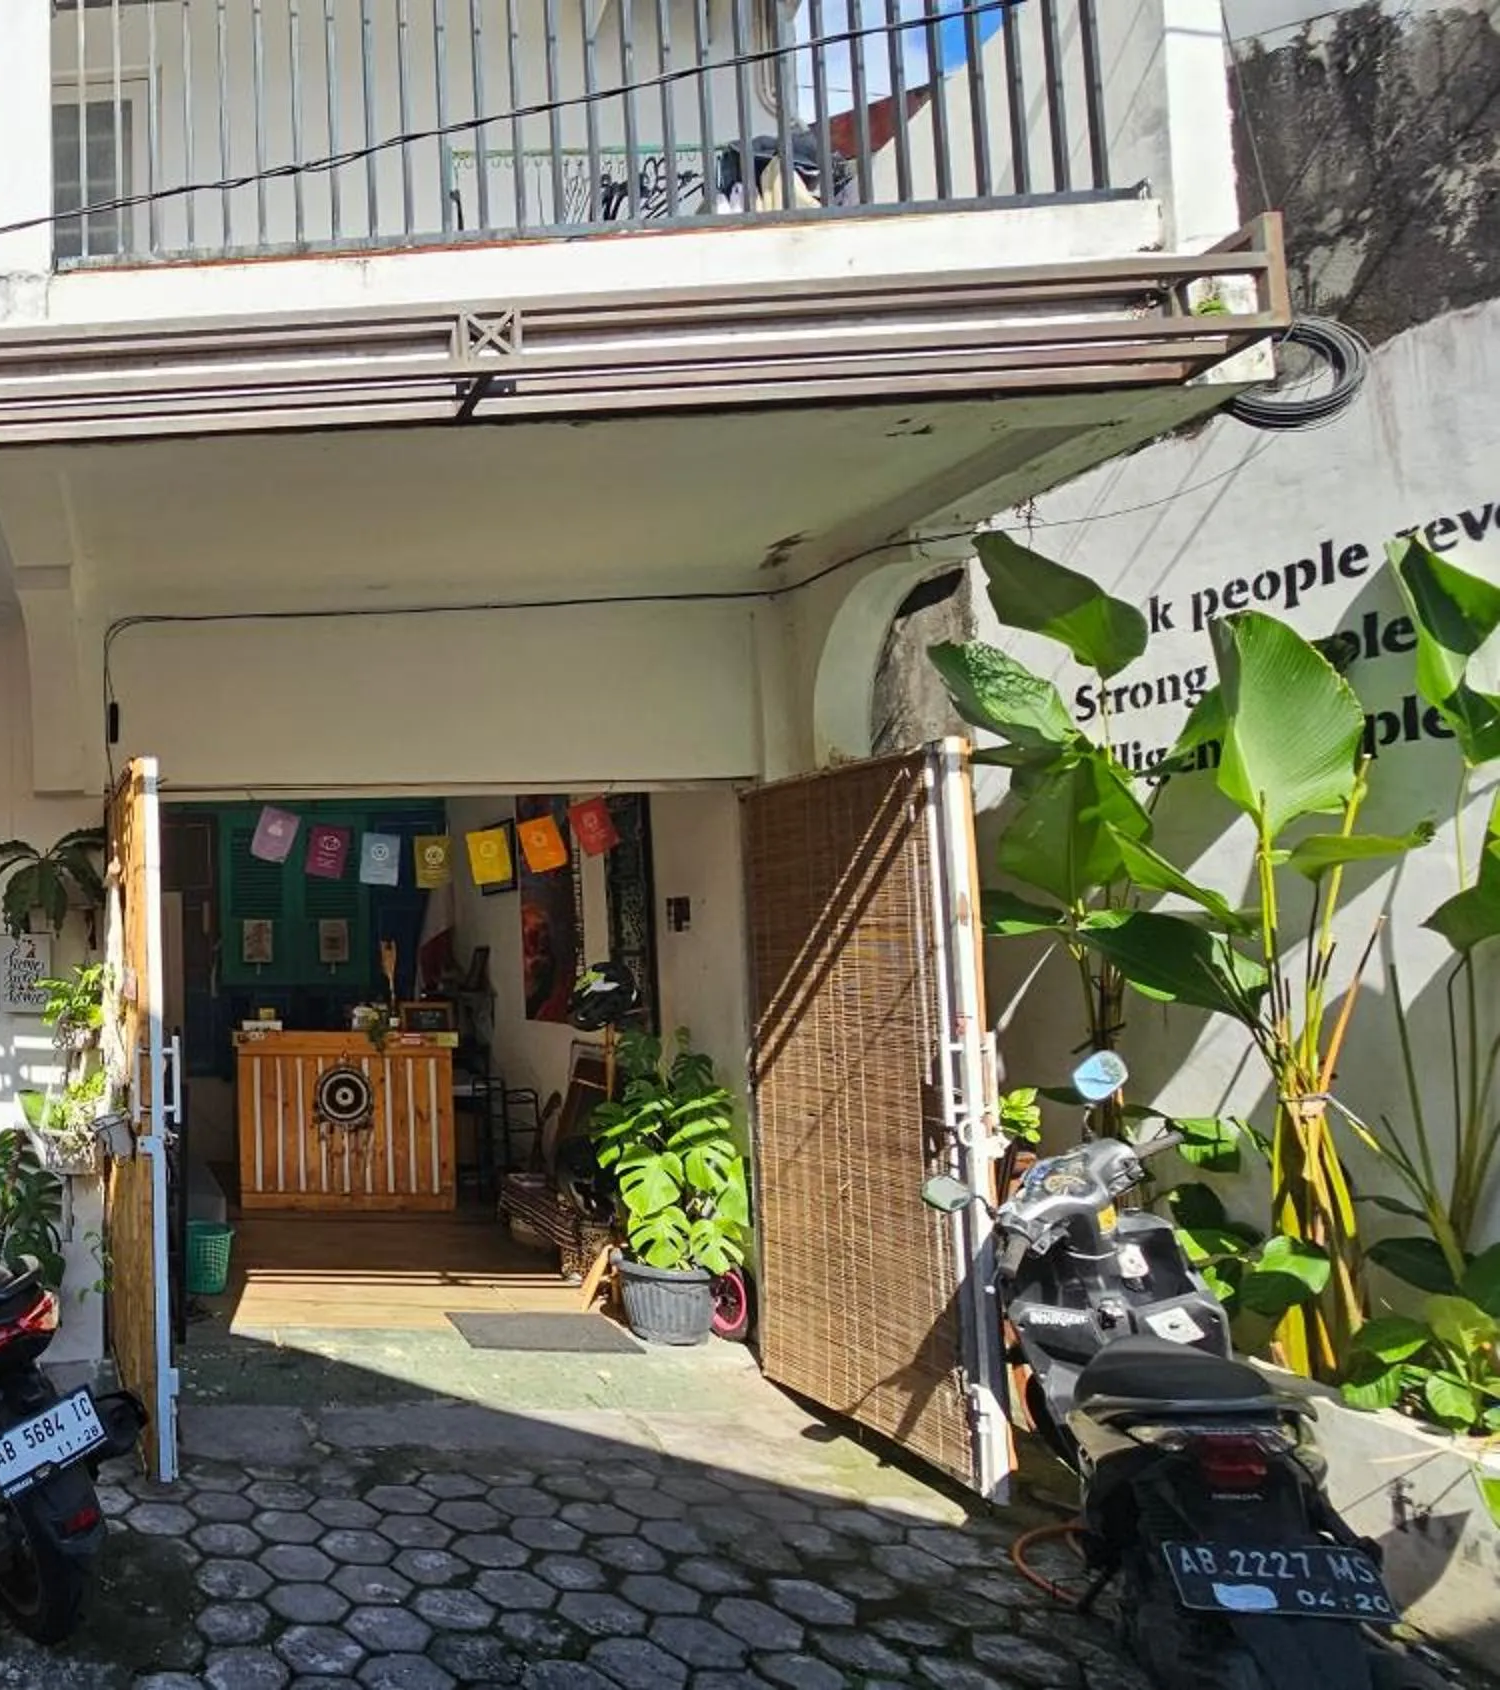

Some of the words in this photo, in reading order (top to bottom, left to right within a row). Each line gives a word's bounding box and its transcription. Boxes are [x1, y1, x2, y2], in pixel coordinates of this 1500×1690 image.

[1191, 539, 1369, 633] people
[1075, 664, 1208, 723] Strong
[23, 1411, 65, 1449] 5684
[1180, 1547, 1218, 1575] AB
[1228, 1549, 1311, 1580] 2227
[1325, 1553, 1376, 1584] MS
